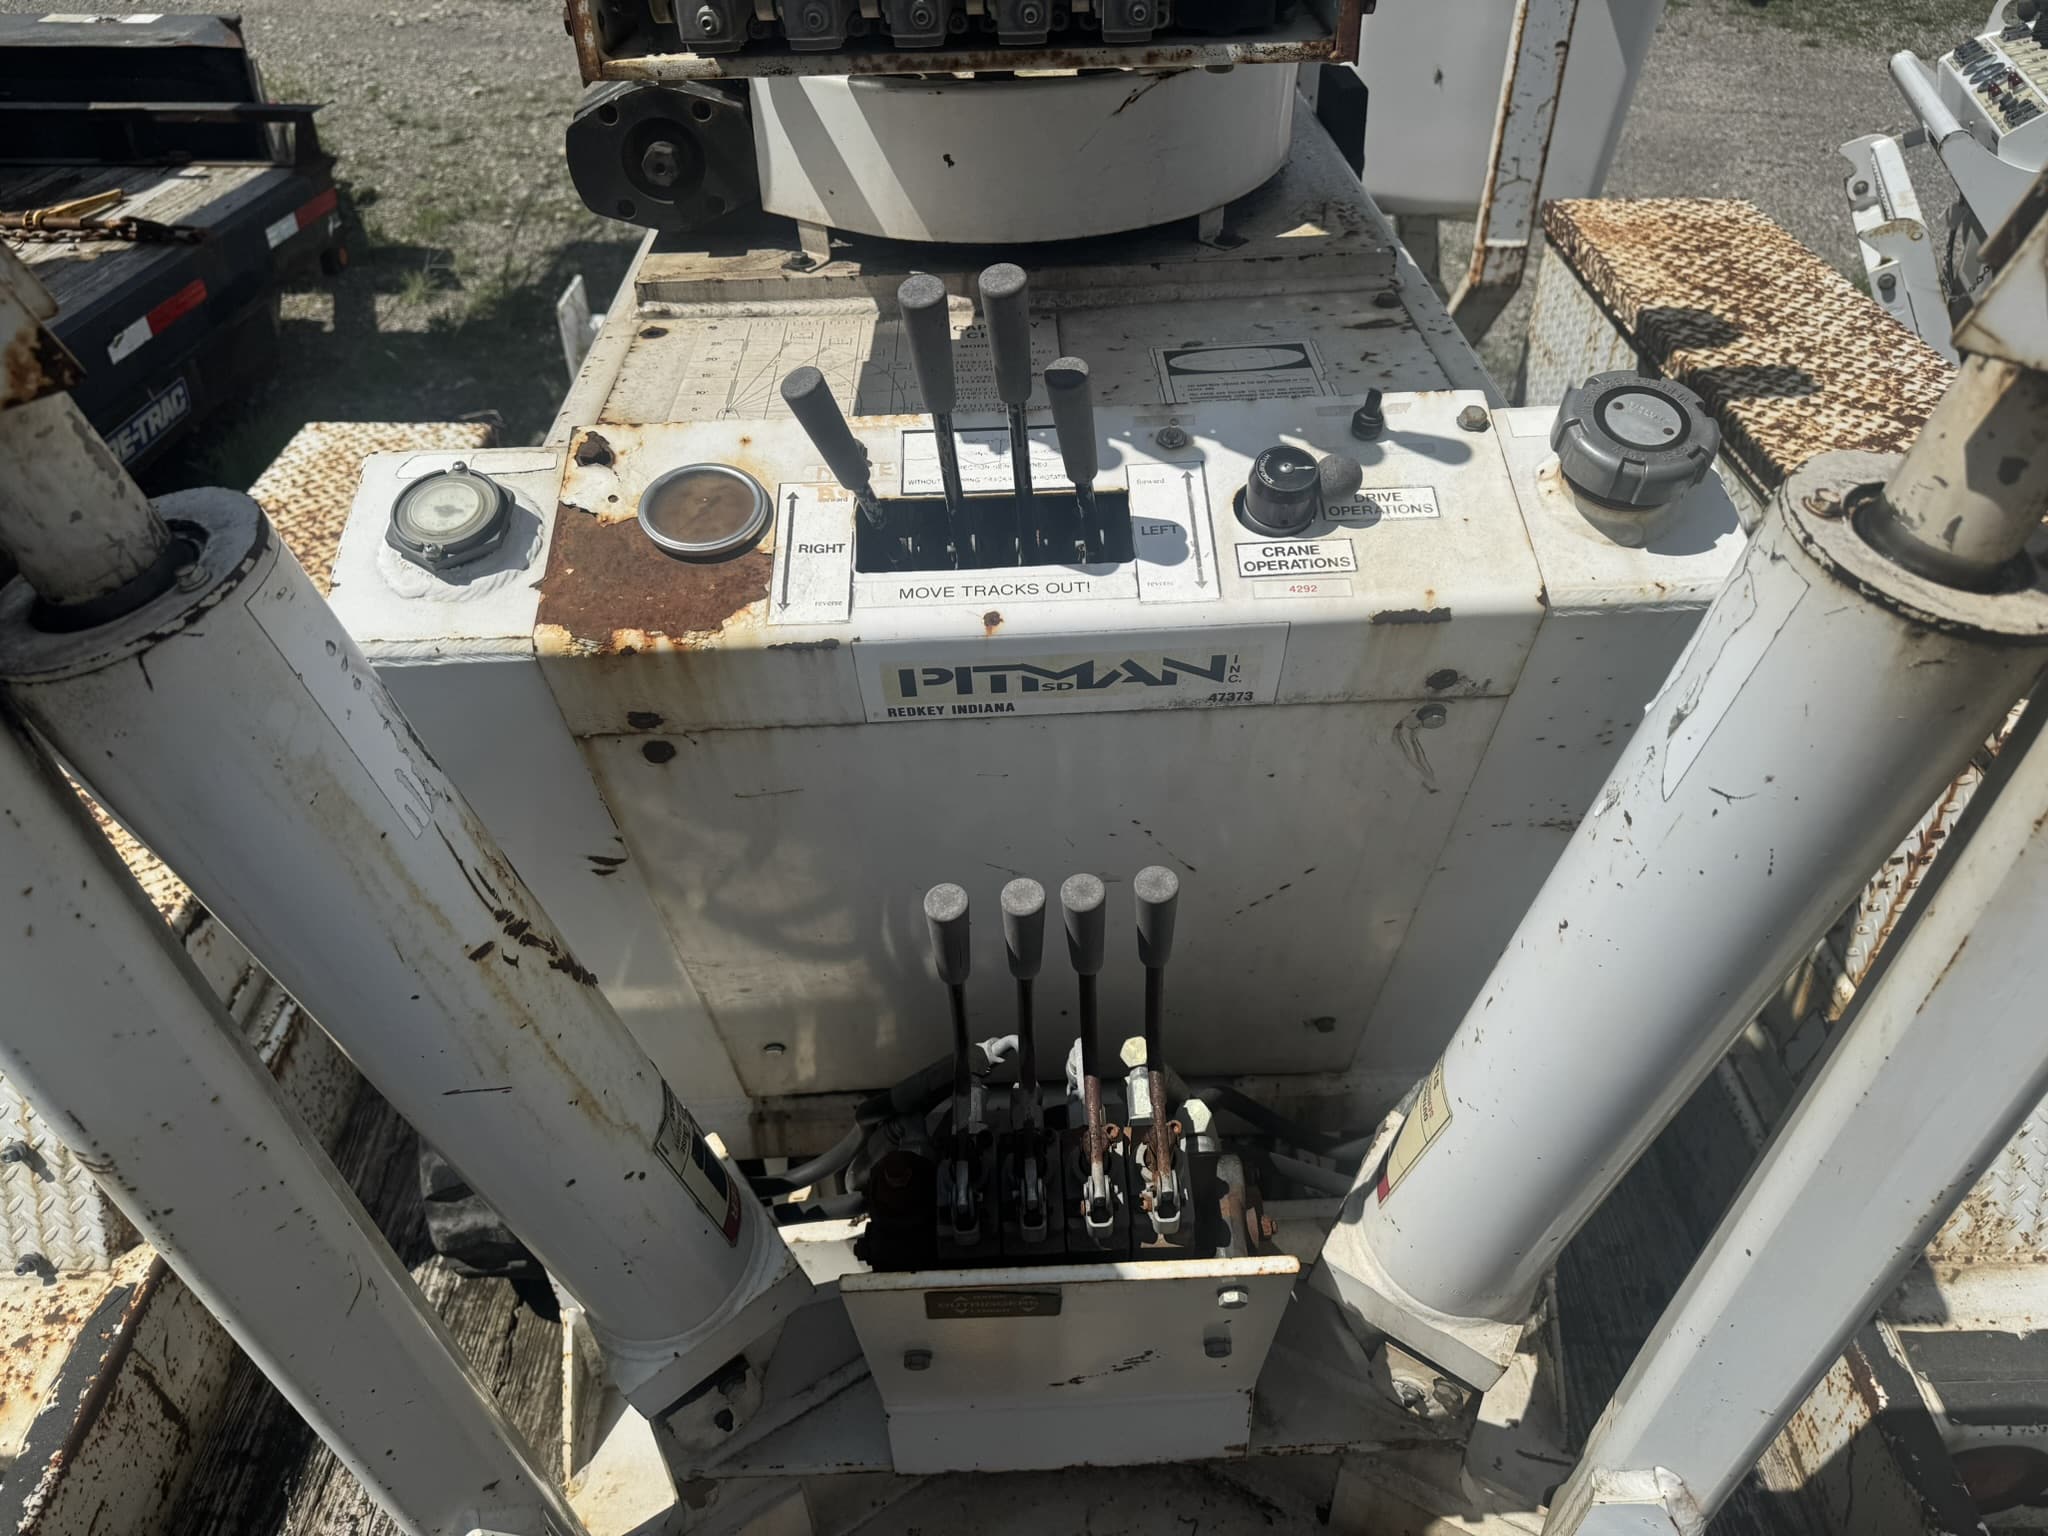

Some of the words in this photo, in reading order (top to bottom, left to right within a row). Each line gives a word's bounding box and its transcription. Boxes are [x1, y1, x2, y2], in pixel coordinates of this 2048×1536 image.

[1354, 491, 1402, 504] DRIVE
[1328, 502, 1434, 517] OPERATIONS
[1141, 524, 1178, 536] LEFT
[798, 543, 846, 554] RIGHT
[1262, 545, 1321, 557] CRANE
[1243, 556, 1351, 572] OPERATIONS
[899, 585, 955, 600] MOVE
[962, 582, 1040, 598] TRACKS
[1046, 581, 1091, 594] OUT!
[1289, 584, 1318, 593] 4292
[898, 654, 1228, 698] PITMAN
[1041, 682, 1074, 691] SD
[1207, 691, 1254, 703] 47373
[888, 705, 945, 718] REDKEY
[951, 702, 1016, 715] INDIANA
